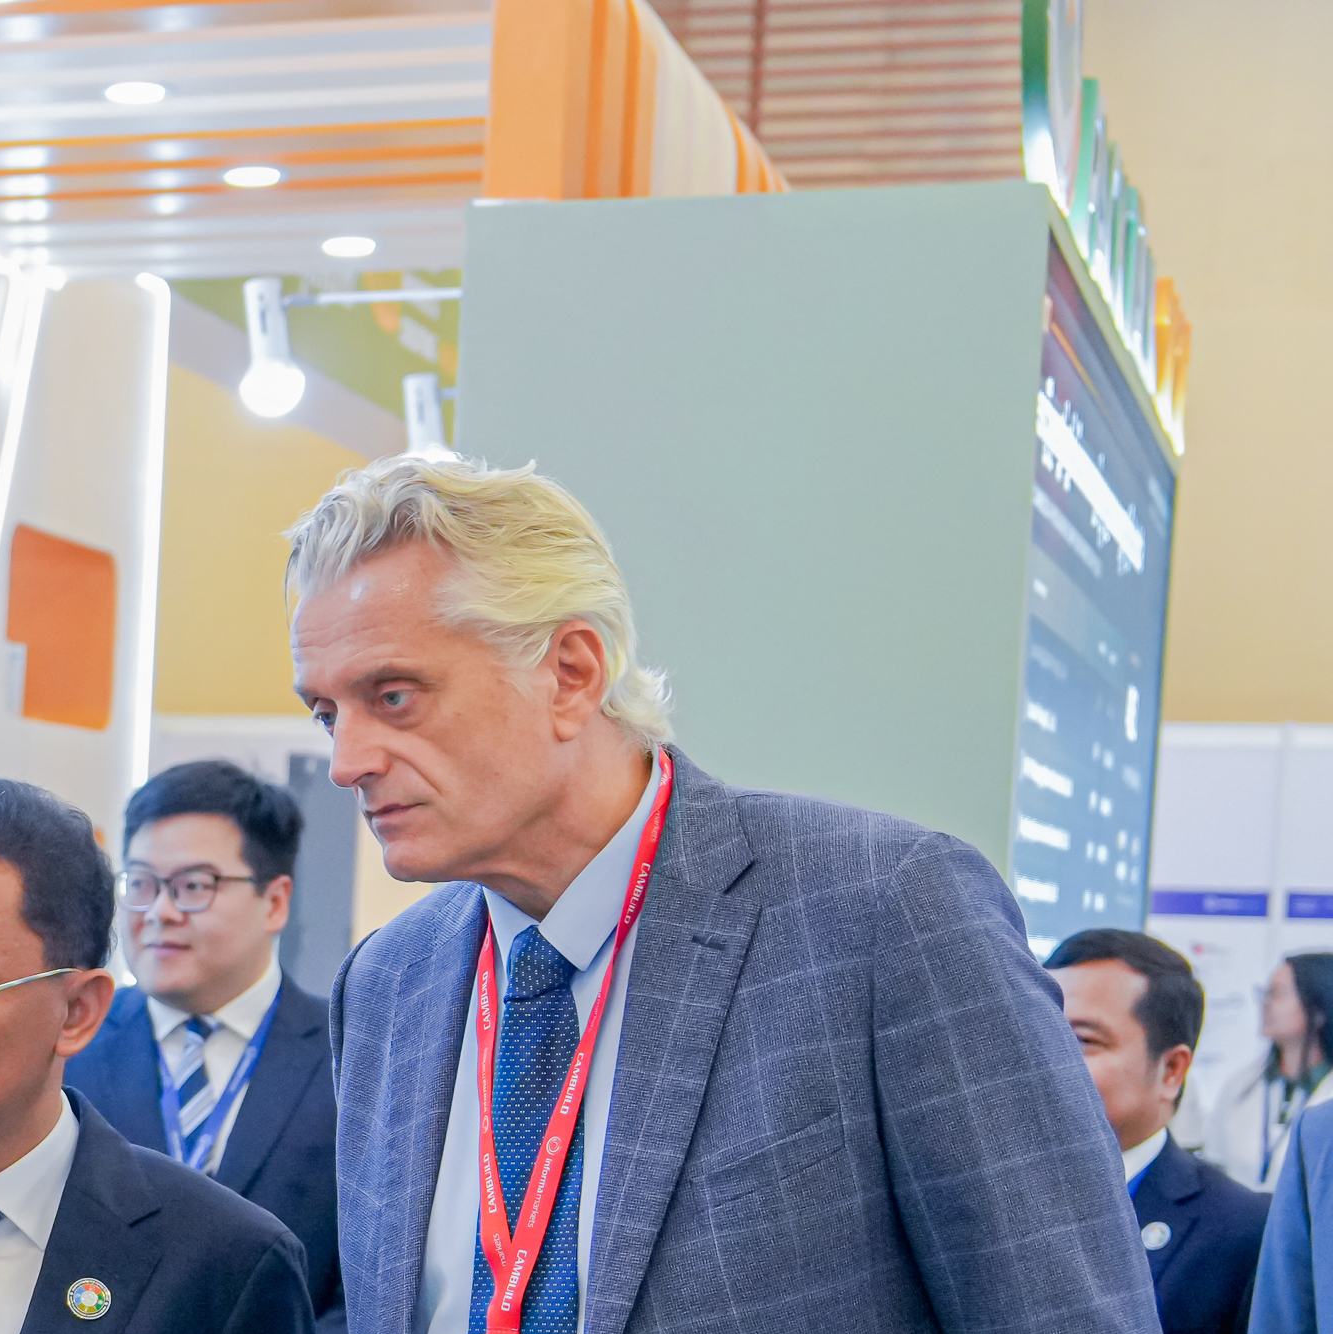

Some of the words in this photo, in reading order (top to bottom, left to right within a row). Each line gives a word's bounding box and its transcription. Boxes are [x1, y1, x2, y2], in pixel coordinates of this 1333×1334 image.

[624, 862, 651, 924] CAMBUILD
[480, 971, 492, 1031] CAMBUILD
[560, 1052, 585, 1115] CAMBUILD
[483, 1153, 498, 1214] CAMBUILD
[500, 1249, 528, 1312] CAMBUILD
